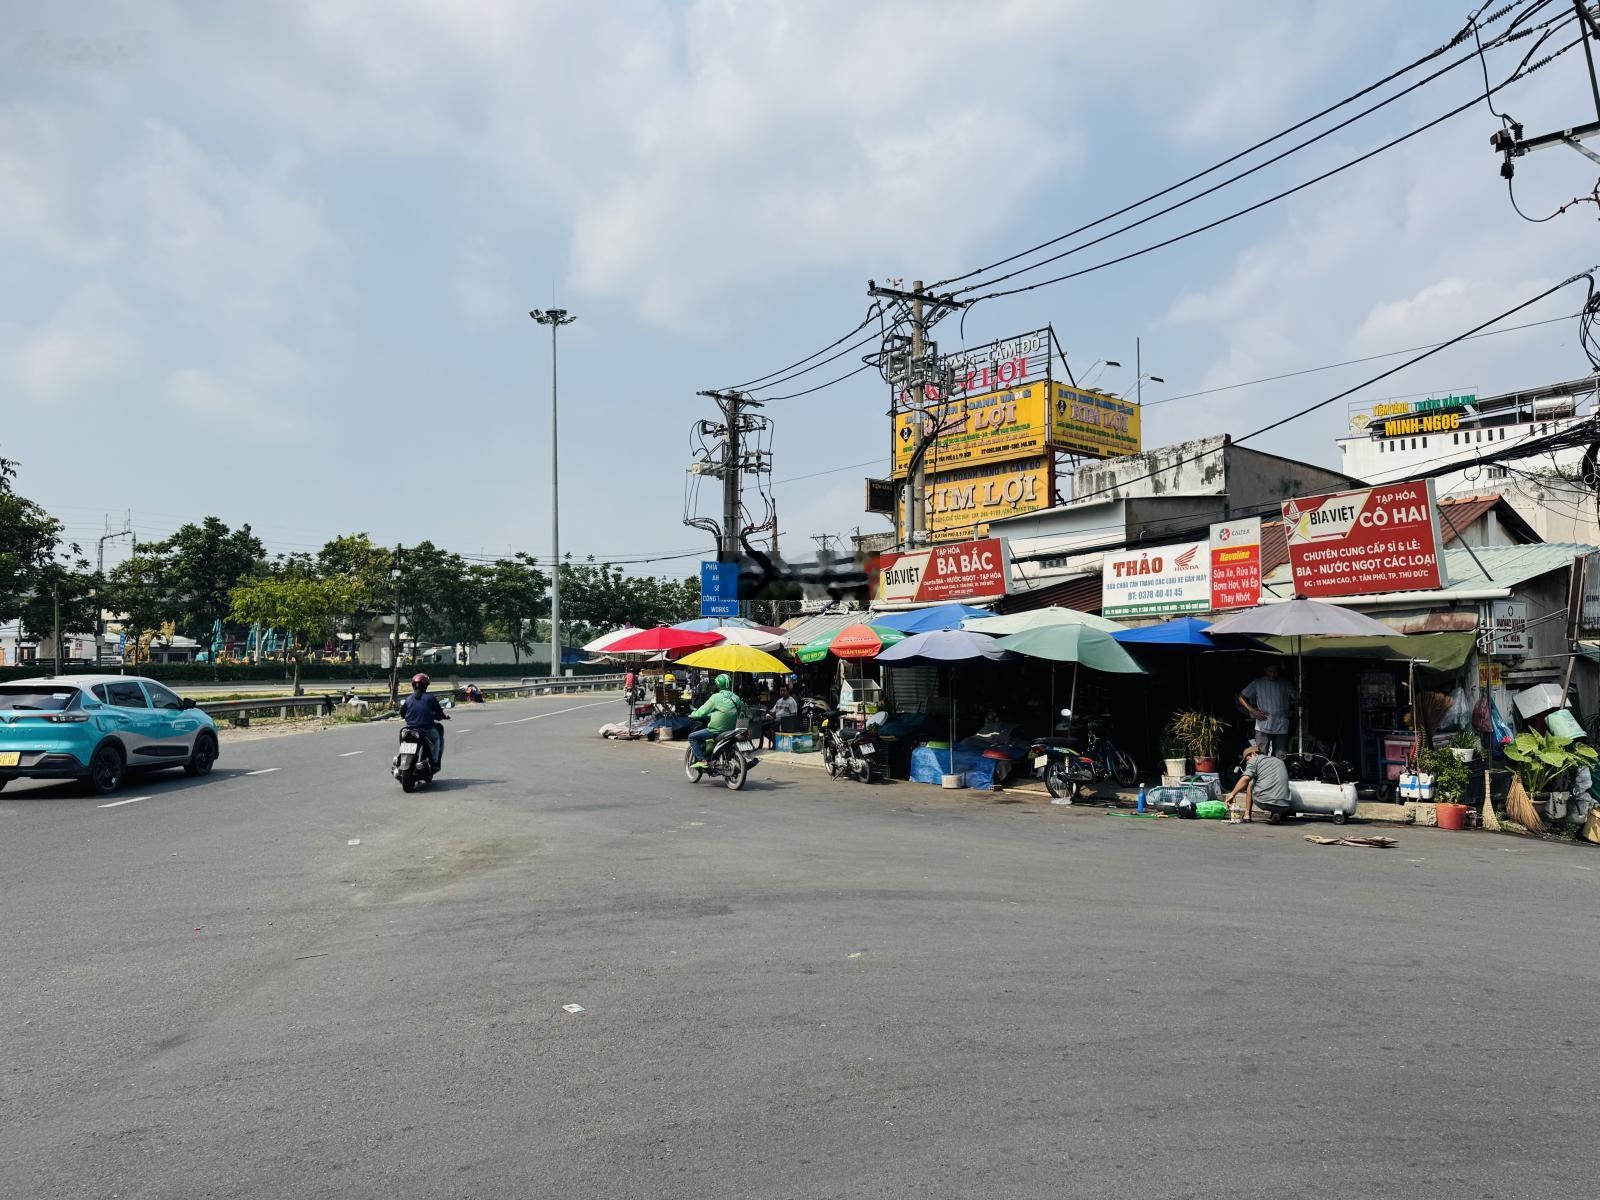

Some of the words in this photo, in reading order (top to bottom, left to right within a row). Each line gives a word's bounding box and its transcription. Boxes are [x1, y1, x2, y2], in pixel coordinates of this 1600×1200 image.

[981, 355, 1028, 389] LỢI
[974, 403, 1017, 430] LỢI
[1384, 417, 1420, 437] MINH
[1422, 413, 1460, 433] NGỌC
[984, 472, 1037, 508] LỢI
[1376, 494, 1394, 505] TẠP
[1396, 489, 1416, 501] HÓA
[1310, 510, 1329, 526] BIA
[1329, 506, 1355, 523] VIỆT
[1359, 507, 1388, 528] CÔ
[1393, 504, 1427, 524] HAI
[937, 558, 958, 575] BA
[960, 547, 993, 572] BẮC
[1220, 550, 1250, 562] Havoline
[1303, 548, 1338, 562] CHUYÊN
[1340, 545, 1364, 558] CUNG
[1366, 540, 1385, 554] CẤP
[1398, 542, 1405, 551] &
[1113, 552, 1164, 577] THẢO
[1249, 566, 1257, 574] Xe
[1296, 567, 1312, 577] BIA
[1320, 560, 1350, 574] NƯỚC
[1352, 558, 1381, 572] NGỌT
[1383, 556, 1406, 568] CÁC
[1409, 554, 1435, 567] LOẠI
[885, 571, 900, 585] BIA
[900, 567, 919, 585] VIỆT
[1213, 581, 1227, 591] Bơm
[1241, 578, 1249, 588] Vá
[1322, 577, 1336, 585] NAM
[1359, 573, 1372, 581] TÂN
[1138, 590, 1154, 600] 0378
[1156, 589, 1164, 598] 40
[1174, 587, 1183, 597] 45
[1220, 593, 1235, 605] Thay
[1236, 592, 1251, 601] Nhớt
